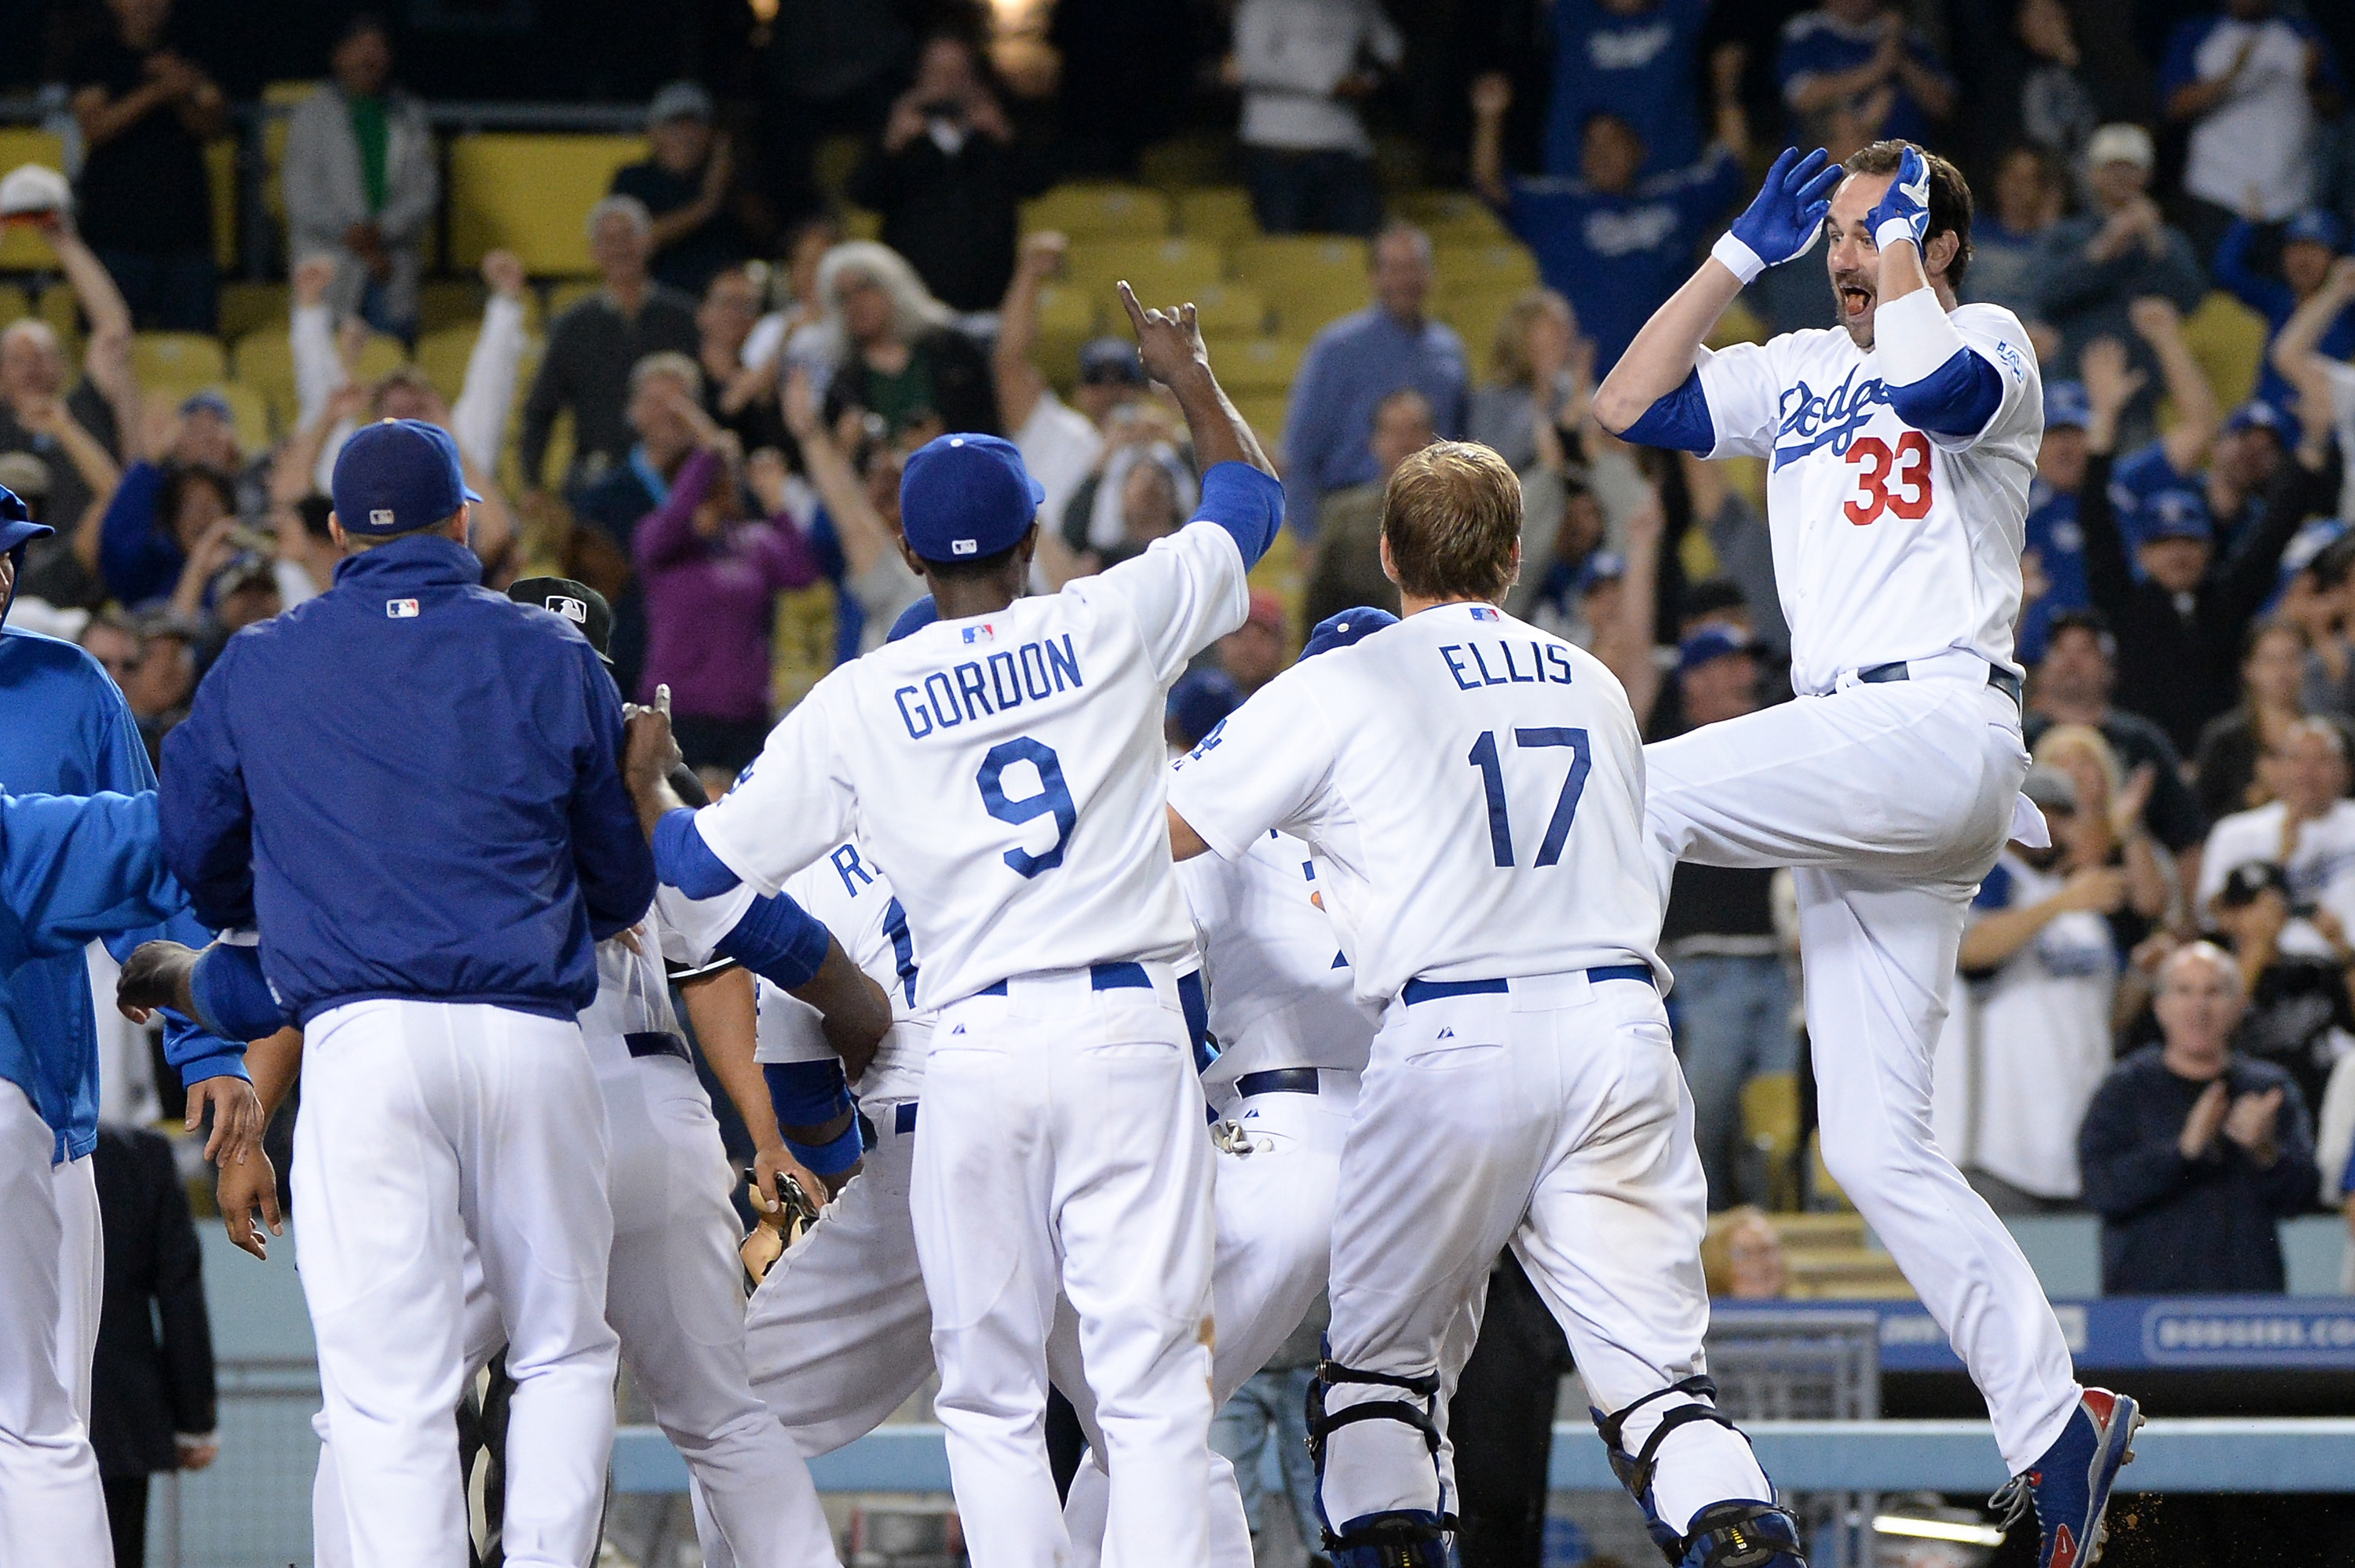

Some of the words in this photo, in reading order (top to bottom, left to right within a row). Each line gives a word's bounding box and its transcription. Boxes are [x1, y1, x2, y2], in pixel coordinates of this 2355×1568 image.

[1843, 431, 1933, 527] 33
[894, 633, 1083, 740] GORDON
[1438, 640, 1572, 691] ELLIS
[976, 735, 1077, 880] 9
[1468, 727, 1592, 869] 17
[830, 844, 883, 899] R
